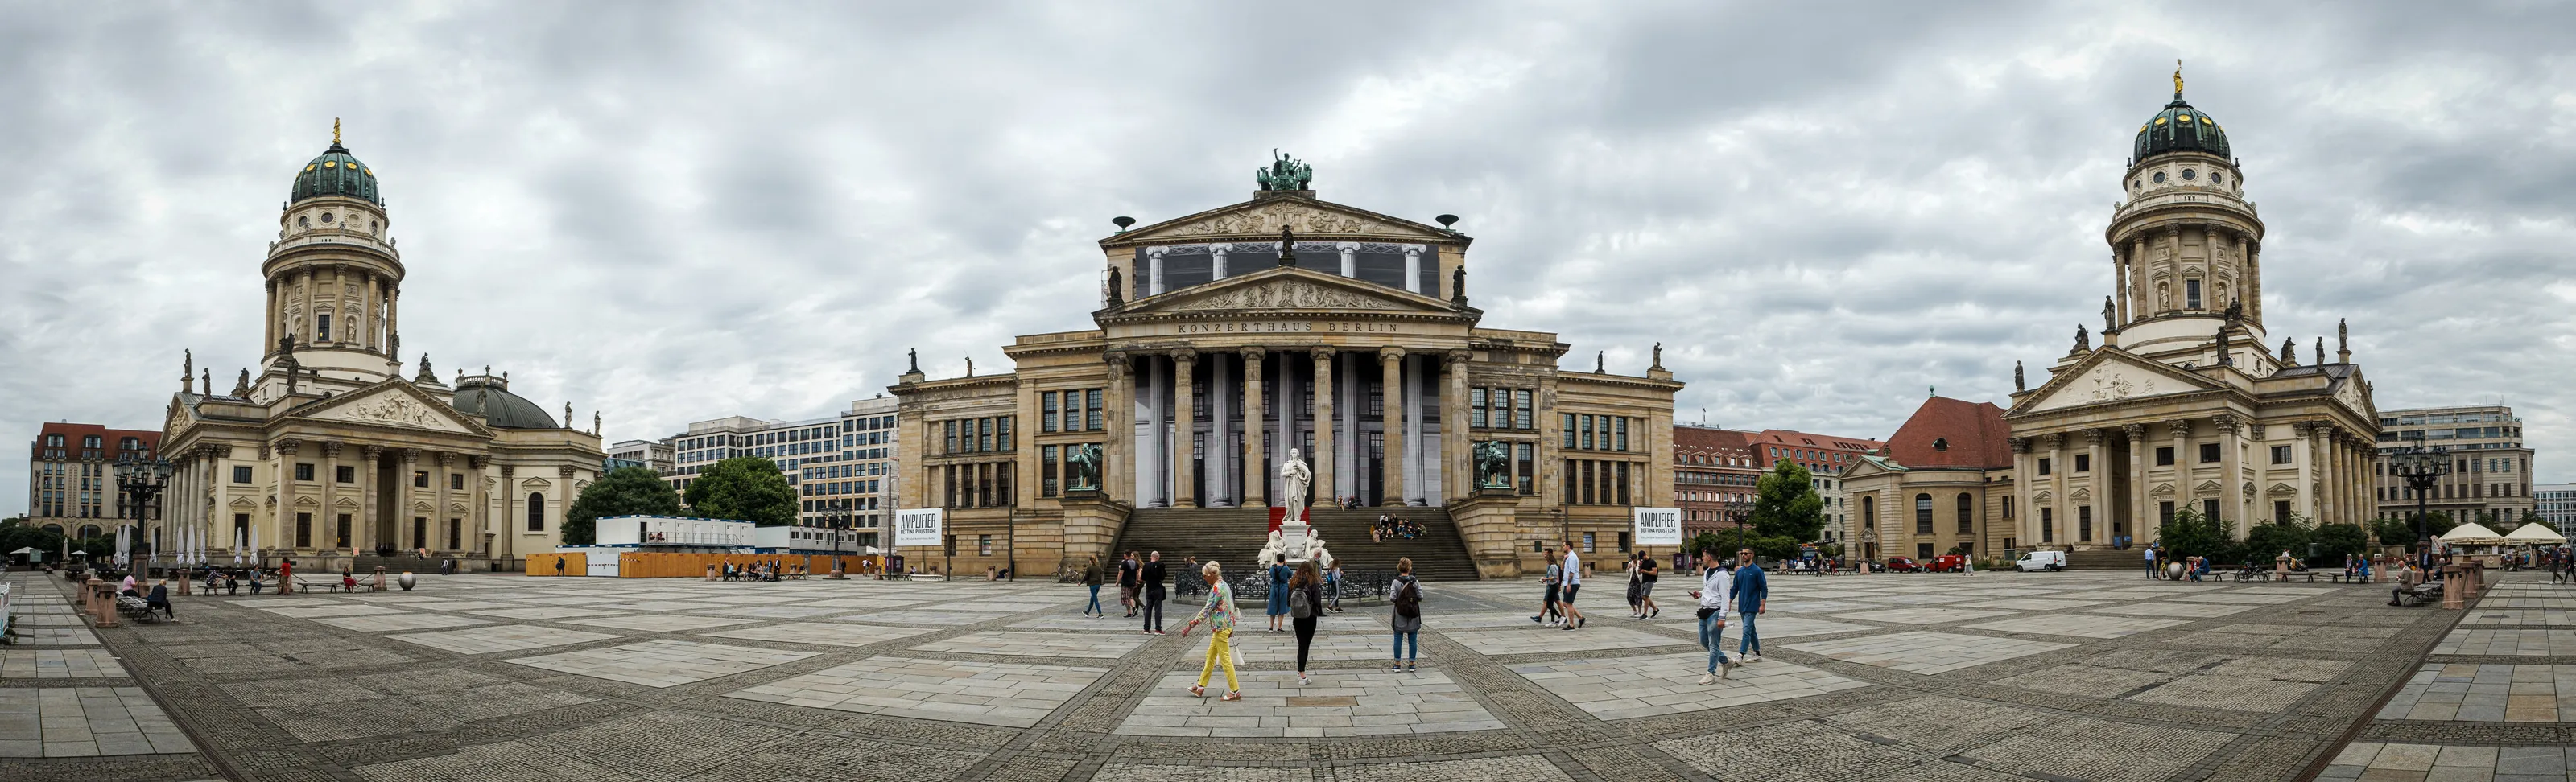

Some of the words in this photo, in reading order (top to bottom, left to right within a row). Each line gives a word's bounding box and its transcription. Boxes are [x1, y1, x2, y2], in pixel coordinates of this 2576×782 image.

[1178, 323, 1313, 333] KONZERTHAUS
[1329, 323, 1398, 332] BERLIN
[901, 513, 936, 529] AMPLIFIER
[1640, 512, 1676, 528] AMPLIFIER
